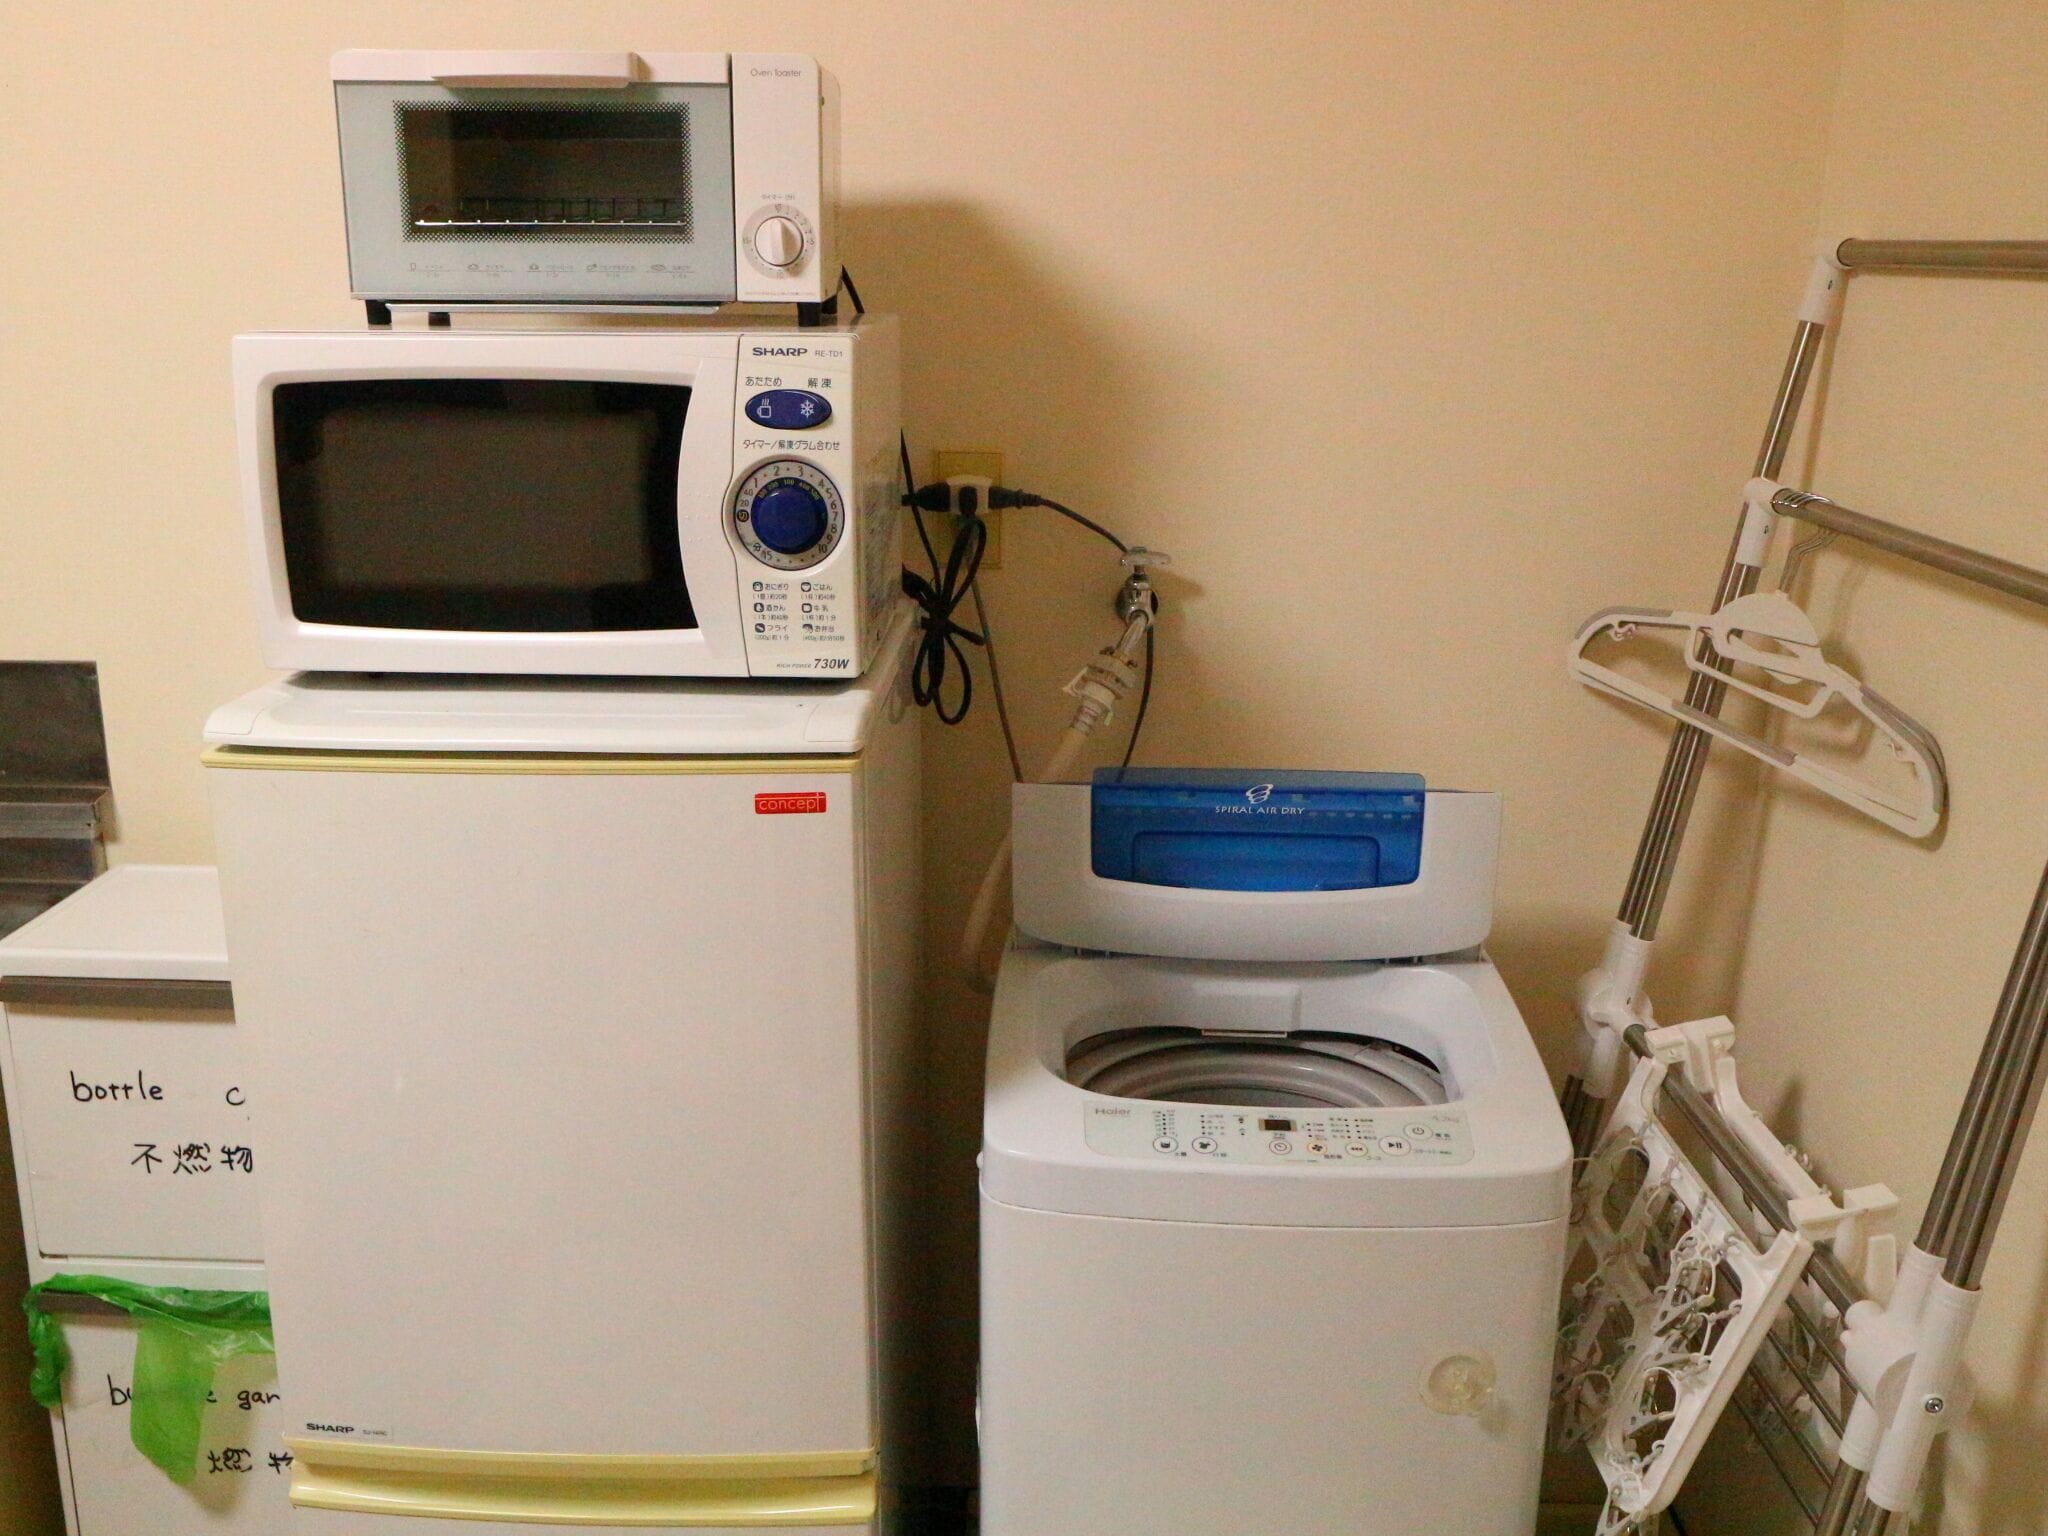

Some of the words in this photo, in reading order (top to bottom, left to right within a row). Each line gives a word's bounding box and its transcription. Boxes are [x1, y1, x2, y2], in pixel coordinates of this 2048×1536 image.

[750, 68, 773, 77] Oven
[774, 68, 801, 77] Toaster
[752, 347, 808, 357] SHARP
[745, 376, 782, 387] あたため
[807, 377, 832, 389] 解凍
[773, 465, 780, 477] 2
[798, 465, 805, 478] 3
[753, 477, 759, 489] 1
[818, 479, 825, 490] 4
[743, 488, 754, 497] 40
[825, 489, 832, 500] 5
[740, 500, 750, 508] 20
[830, 501, 838, 511] 6
[832, 512, 839, 522] 7
[830, 524, 838, 534] 8
[826, 534, 834, 545] 9
[817, 543, 828, 554] 10
[762, 549, 774, 561] 15
[814, 658, 850, 669] 730W
[1215, 805, 1254, 814] SPIRAL
[1256, 806, 1278, 814] AIR
[70, 1070, 164, 1102] bottle
[131, 1142, 254, 1175] 不燃物
[306, 1423, 355, 1434] SHARP
